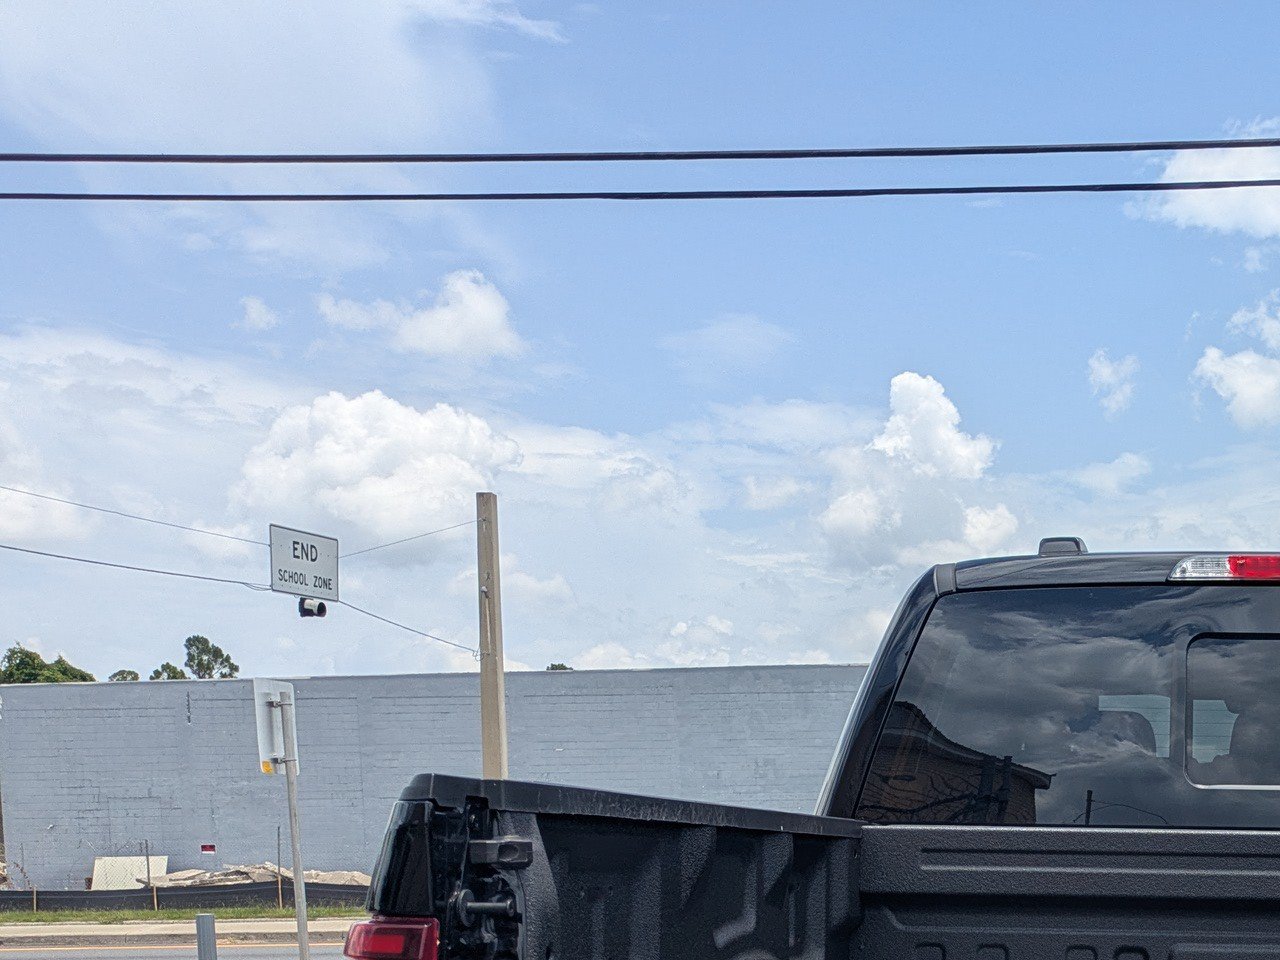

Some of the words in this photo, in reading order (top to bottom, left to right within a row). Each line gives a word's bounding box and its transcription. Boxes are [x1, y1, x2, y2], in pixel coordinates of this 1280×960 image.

[292, 541, 318, 562] END
[278, 568, 309, 586] SCHOOL
[313, 575, 333, 590] ZONE
